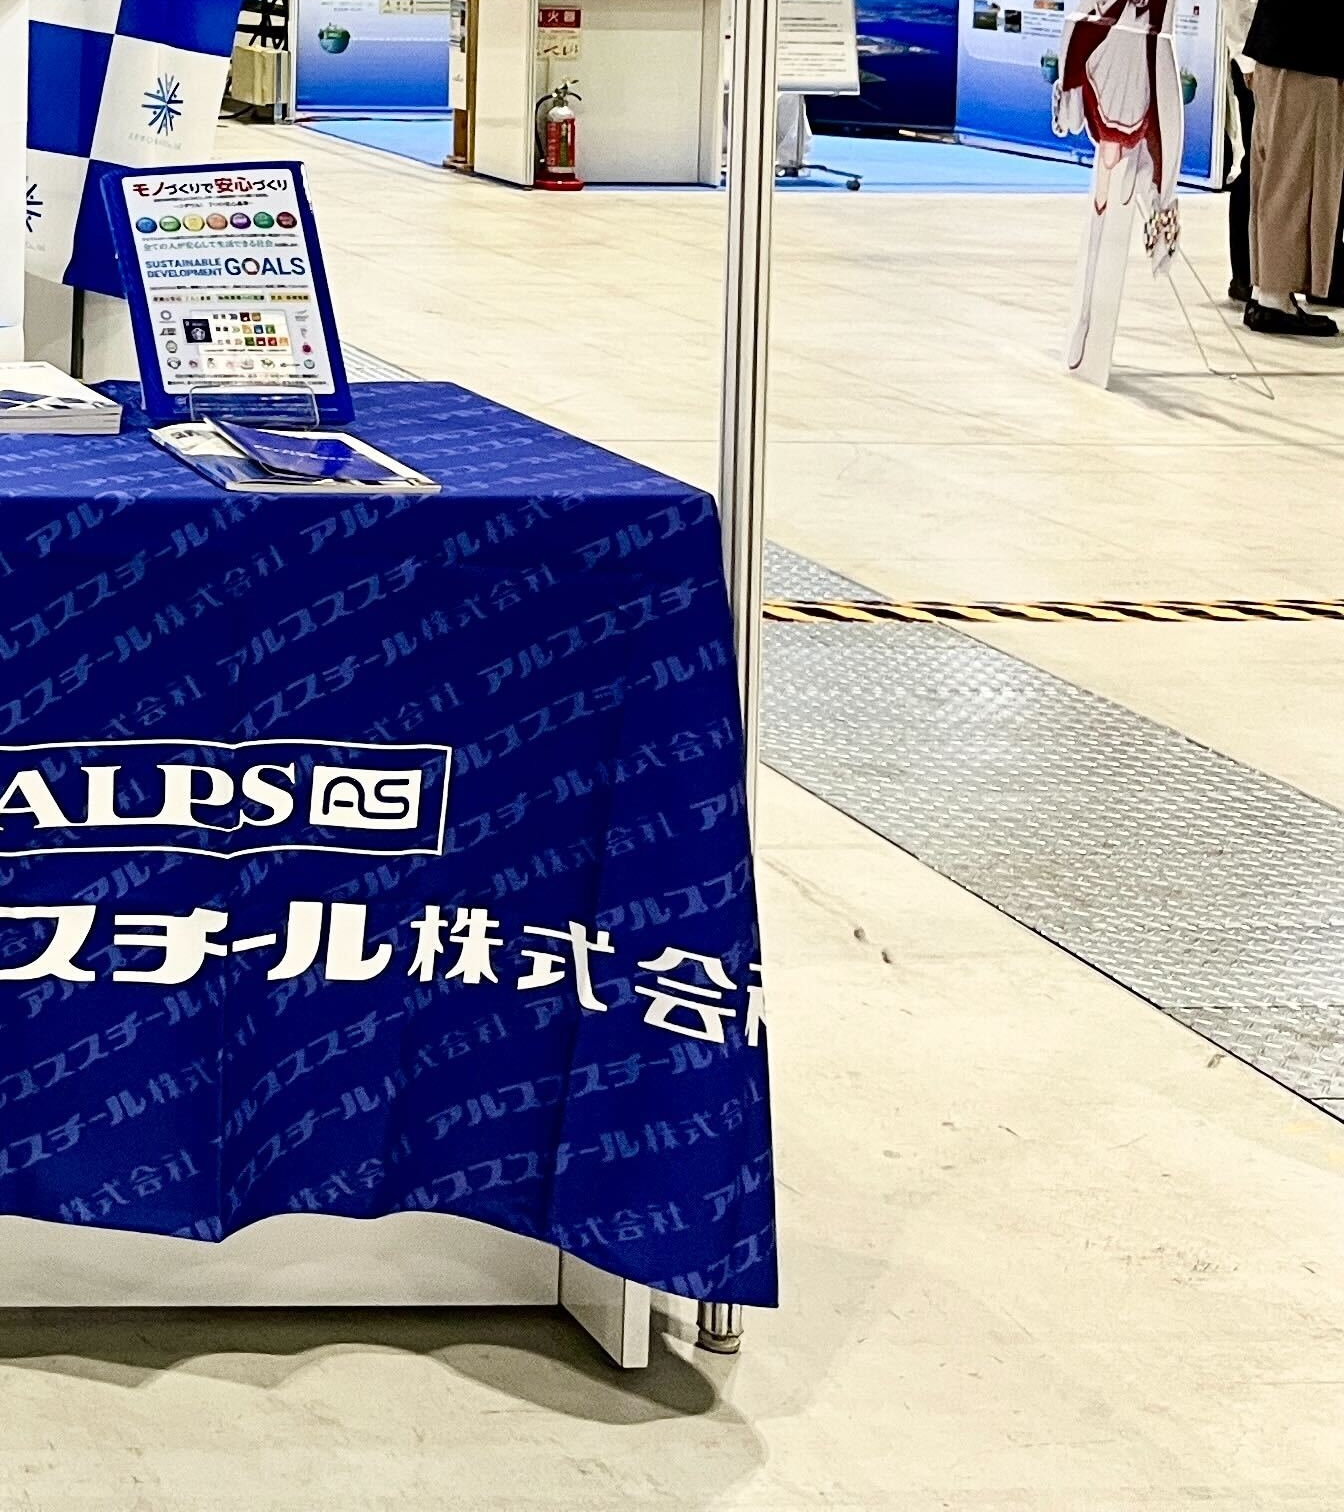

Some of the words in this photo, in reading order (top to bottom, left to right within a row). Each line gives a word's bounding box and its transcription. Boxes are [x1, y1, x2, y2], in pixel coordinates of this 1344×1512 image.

[132, 176, 288, 197] モノづくりで安心づくり
[145, 258, 222, 269] SUSTAINABLE
[224, 257, 306, 276] GOALS
[147, 267, 222, 278] DEVELOPMENT
